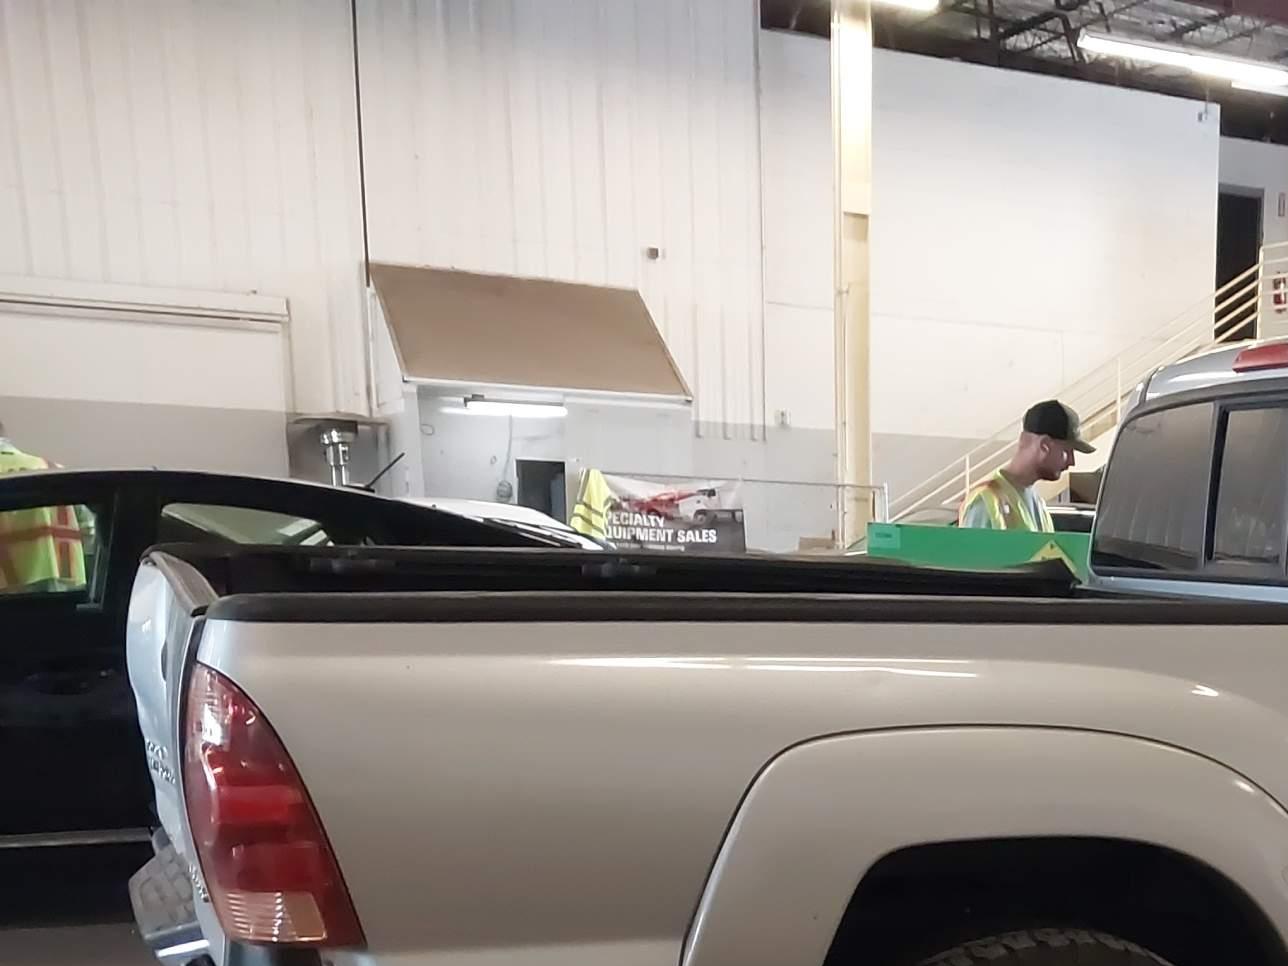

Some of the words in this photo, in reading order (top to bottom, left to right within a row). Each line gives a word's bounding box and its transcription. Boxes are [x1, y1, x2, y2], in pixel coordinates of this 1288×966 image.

[606, 511, 665, 528] PECIALTY
[605, 525, 674, 543] QUIPMENT
[677, 529, 718, 543] SALES
